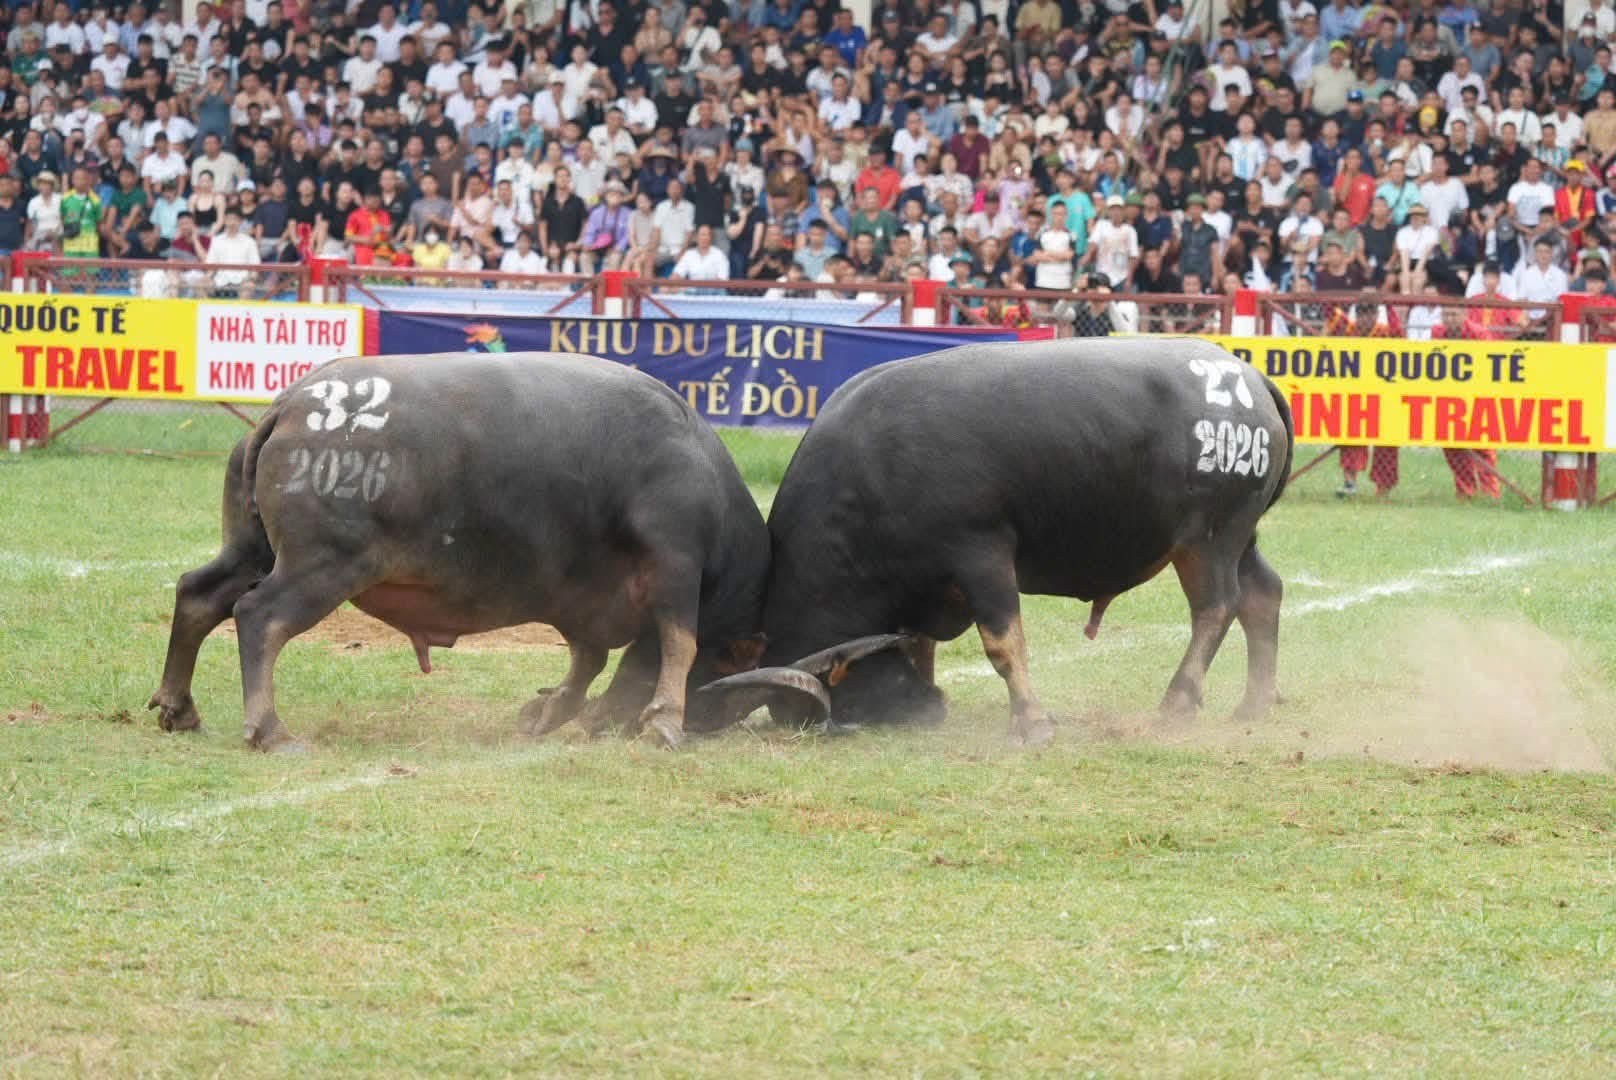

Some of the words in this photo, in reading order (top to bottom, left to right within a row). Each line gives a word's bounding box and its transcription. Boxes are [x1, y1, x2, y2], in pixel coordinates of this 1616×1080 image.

[0, 298, 79, 333] QUỐC
[92, 302, 128, 335] TẾ
[210, 314, 255, 343] NHÀ
[264, 315, 296, 345] TÀI
[305, 319, 347, 353] TRỢ
[550, 320, 639, 354] KHU
[652, 322, 712, 356] DU
[725, 324, 824, 367] LỊCH
[1266, 343, 1361, 378] ĐOÀN
[1375, 345, 1474, 383] QUỐC
[1487, 347, 1529, 383] TẾ
[16, 346, 183, 392] TRAVEL
[209, 362, 255, 390] KIM
[678, 366, 731, 416] TẾ
[741, 368, 817, 419] ĐỒI
[1189, 359, 1254, 408] 27
[303, 377, 392, 433] 32
[1401, 395, 1590, 445] TRAVEL
[1194, 420, 1270, 478] 2026
[276, 448, 391, 502] 2026
